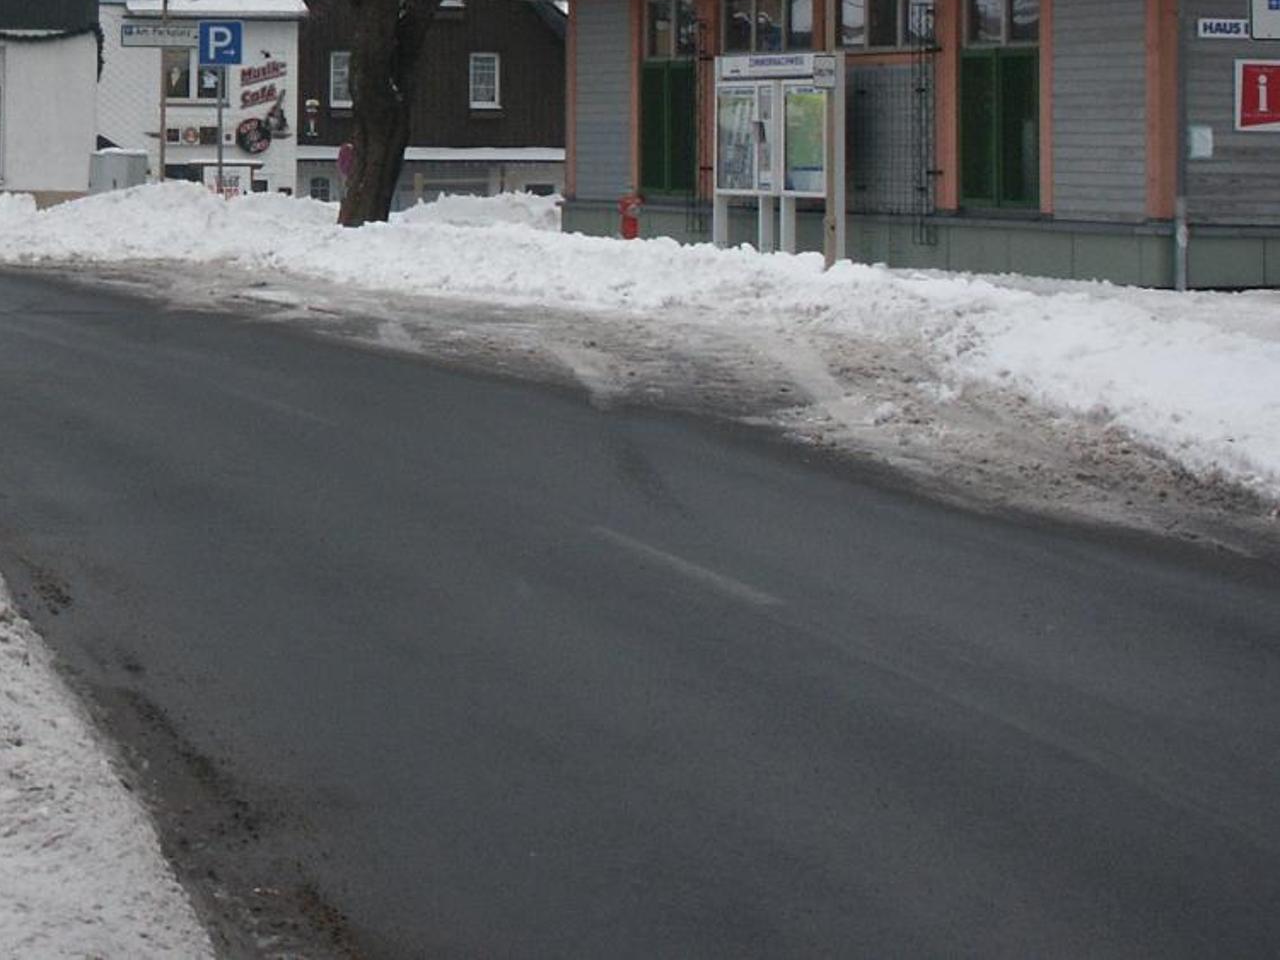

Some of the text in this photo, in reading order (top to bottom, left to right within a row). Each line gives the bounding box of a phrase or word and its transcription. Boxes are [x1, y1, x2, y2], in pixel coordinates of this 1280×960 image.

[1203, 22, 1241, 34] HAUS
[209, 27, 232, 60] P
[241, 84, 277, 106] Café
